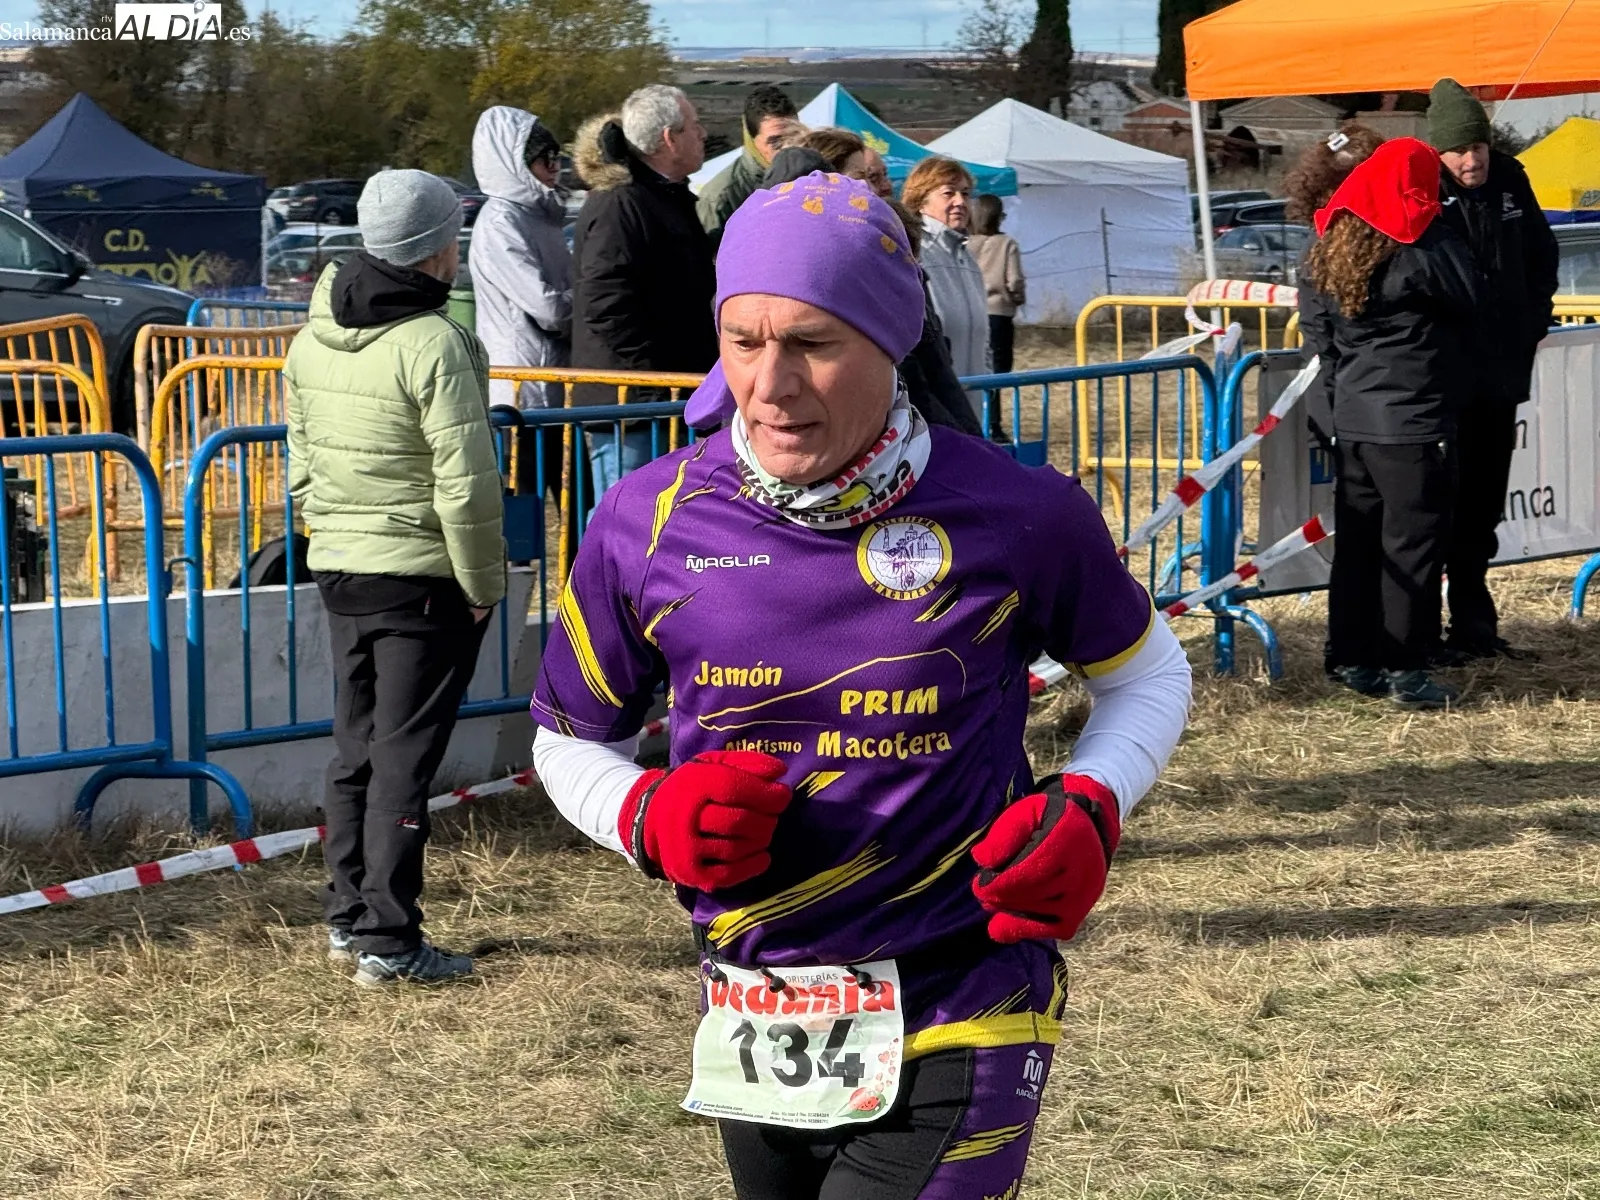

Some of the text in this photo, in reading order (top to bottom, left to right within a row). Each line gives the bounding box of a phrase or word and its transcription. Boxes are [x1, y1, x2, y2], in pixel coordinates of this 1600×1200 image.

[104, 229, 149, 251] C.D.
[873, 516, 936, 530] ATLETISMO
[685, 554, 770, 573] MAGLIA
[869, 580, 939, 599] MACOTERA
[694, 660, 783, 688] Jamón
[840, 685, 939, 716] PRIM
[817, 730, 952, 760] Macotera
[728, 1018, 866, 1088] 134
